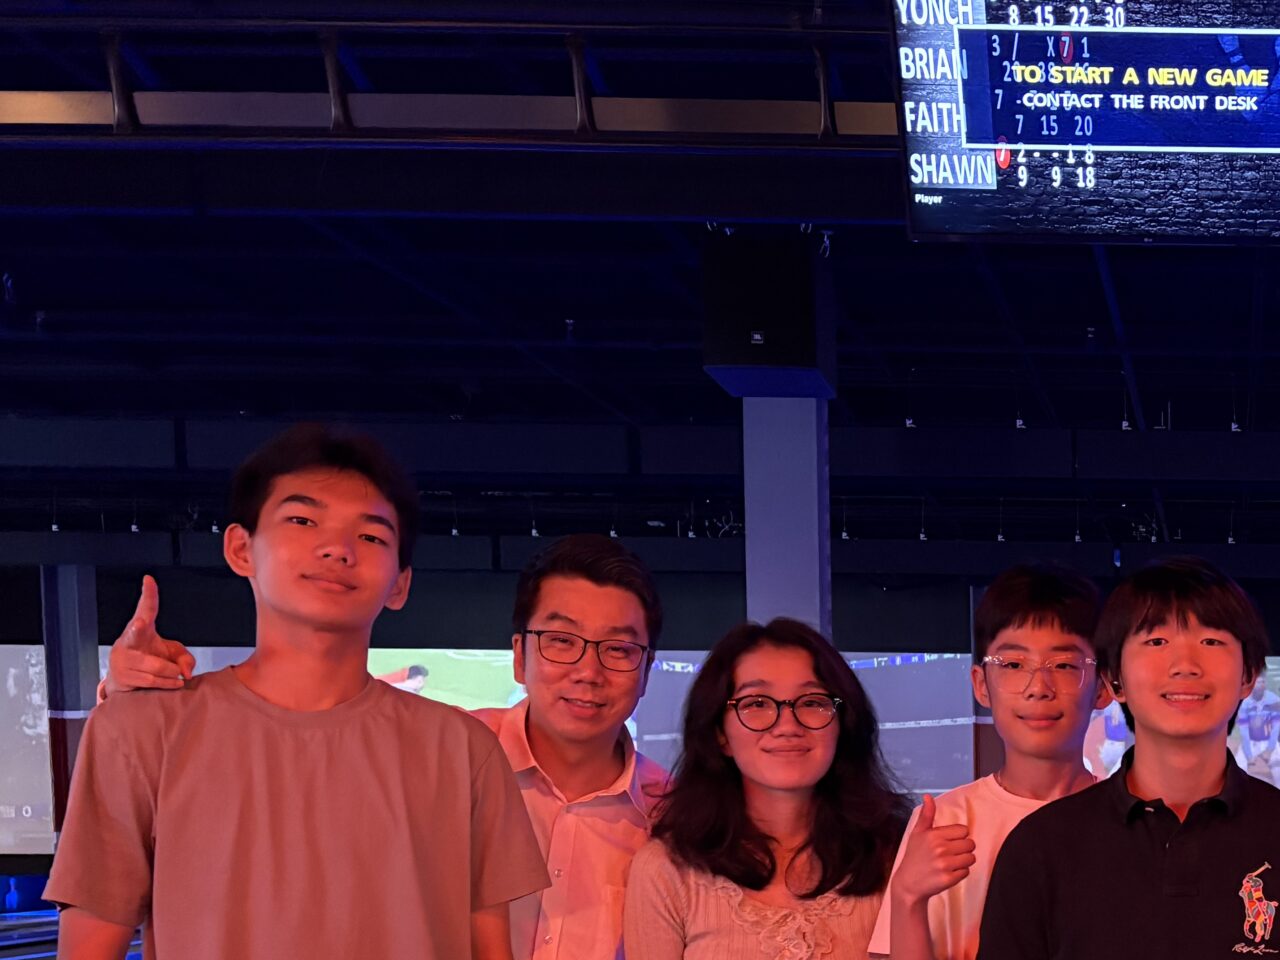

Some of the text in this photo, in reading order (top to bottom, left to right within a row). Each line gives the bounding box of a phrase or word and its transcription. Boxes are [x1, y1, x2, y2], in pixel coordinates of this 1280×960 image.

[898, 0, 973, 25] YONCH
[1009, 5, 1124, 28] 8 15 22 30
[992, 35, 1001, 56] 3
[1047, 36, 1055, 57] X
[1061, 37, 1069, 57] 7
[1081, 37, 1090, 57] 1
[900, 48, 968, 80] BRIAN
[1011, 65, 1269, 87] TO START A NEW GAME
[1022, 93, 1257, 110] CONTACT THE FRONT DESK
[904, 102, 967, 132] FAITH
[1015, 115, 1092, 136] 7 15 20
[910, 153, 993, 184] SHAWN
[1018, 166, 1095, 188] 9 9 18
[915, 194, 943, 205] Player
